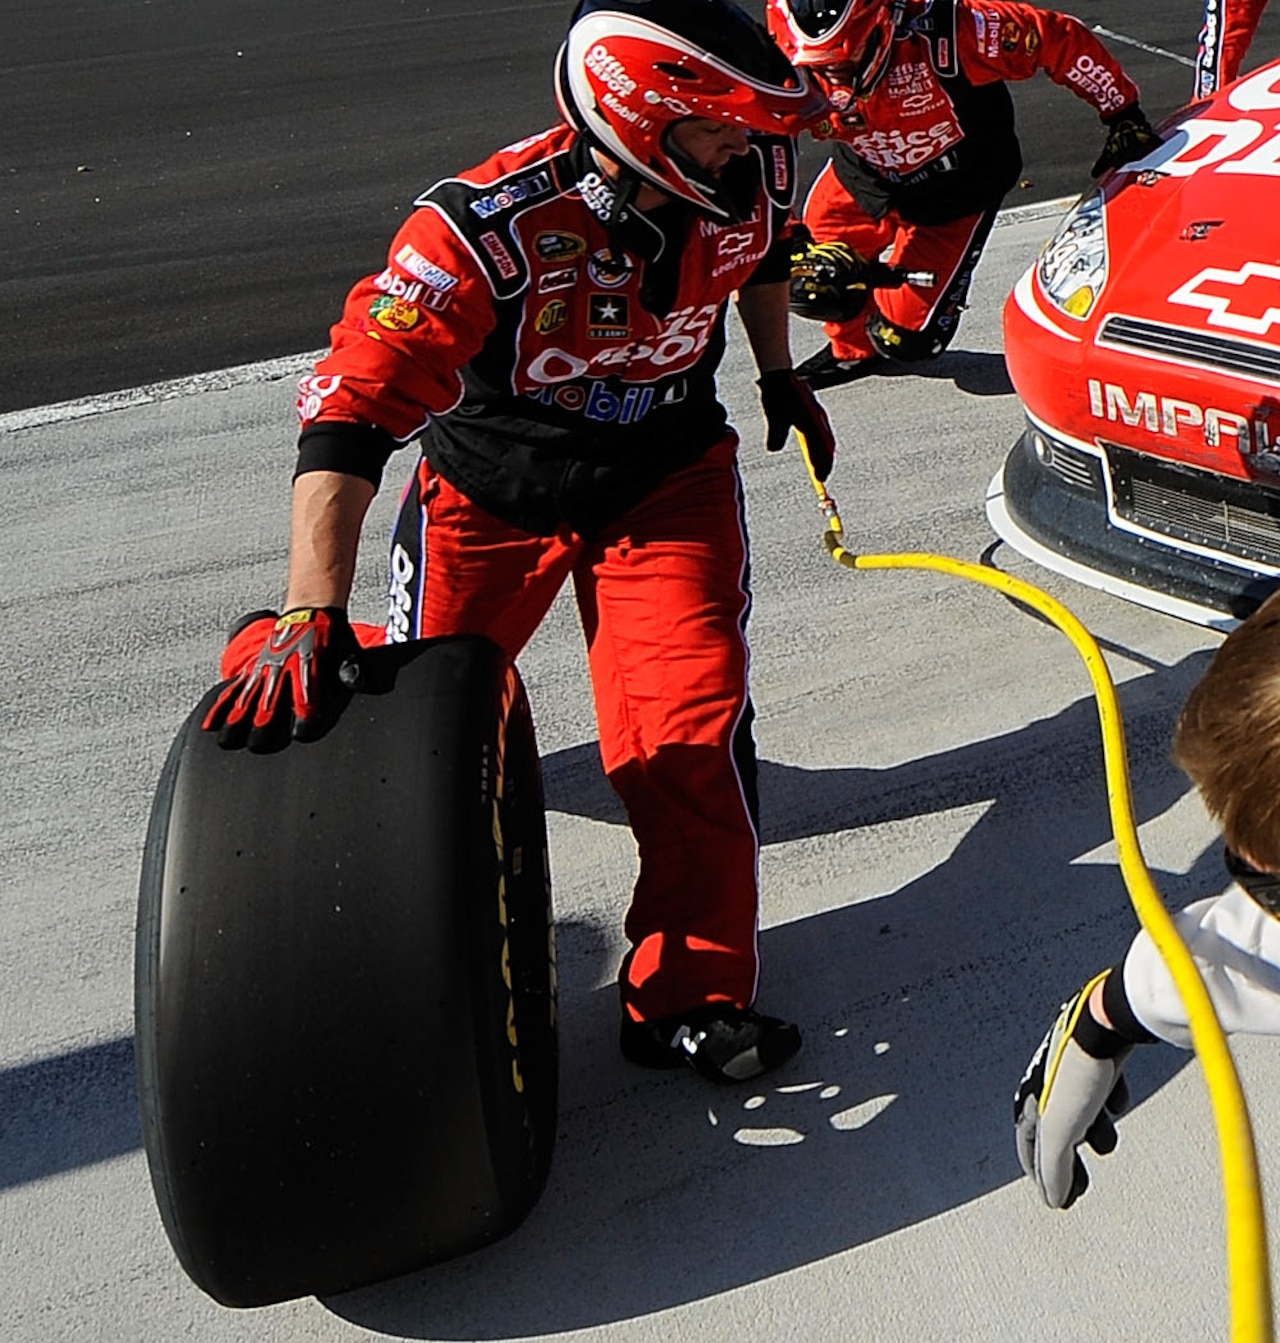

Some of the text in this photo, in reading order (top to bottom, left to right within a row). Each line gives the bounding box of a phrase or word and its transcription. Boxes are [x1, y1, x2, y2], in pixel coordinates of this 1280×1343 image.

[585, 54, 632, 98] DEPOT
[592, 45, 637, 91] Office
[1066, 67, 1115, 112] DEPOT
[1076, 55, 1125, 106] Office
[602, 93, 638, 122] Mobil
[470, 178, 532, 219] Mobil
[480, 233, 518, 279] SIMPSON
